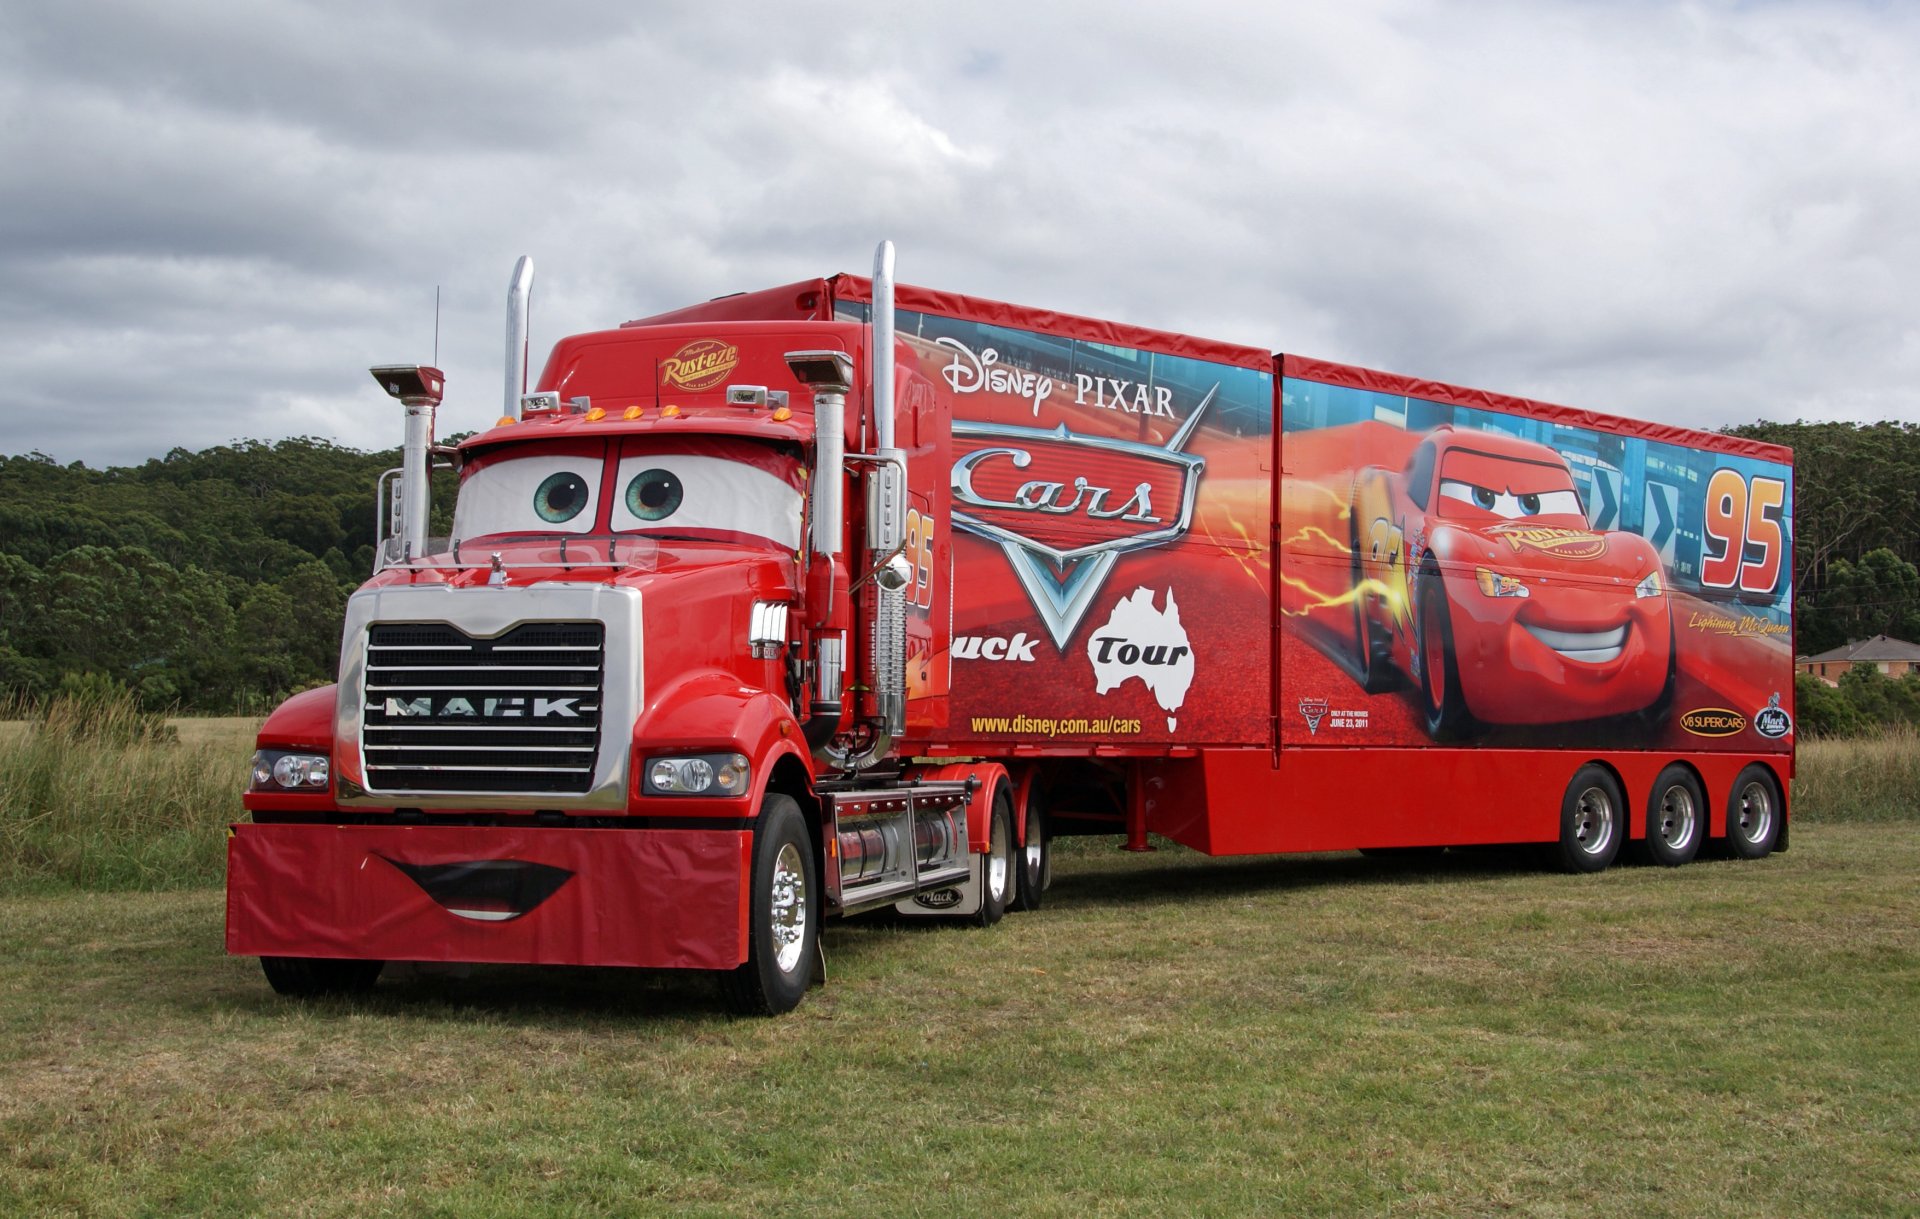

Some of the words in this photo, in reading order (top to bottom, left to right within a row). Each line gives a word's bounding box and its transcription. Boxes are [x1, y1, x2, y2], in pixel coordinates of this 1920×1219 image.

[1075, 373, 1175, 419] PIXAR
[951, 447, 1162, 523] Cars
[1701, 468, 1785, 594] 95
[906, 508, 934, 610] 95
[1501, 576, 1520, 594] 95
[1688, 611, 1737, 633] Lightning
[1739, 616, 1790, 637] McQueen
[952, 633, 1040, 662] uck
[1096, 637, 1188, 666] Tour
[385, 697, 581, 717] MACK
[972, 715, 1141, 737] www.disney.com.au/cars
[1330, 718, 1345, 728] JUNE
[1345, 718, 1355, 730] 23,
[1355, 719, 1369, 728] 2011
[1681, 716, 1695, 728] V8
[1694, 716, 1745, 729] SUPERCARS
